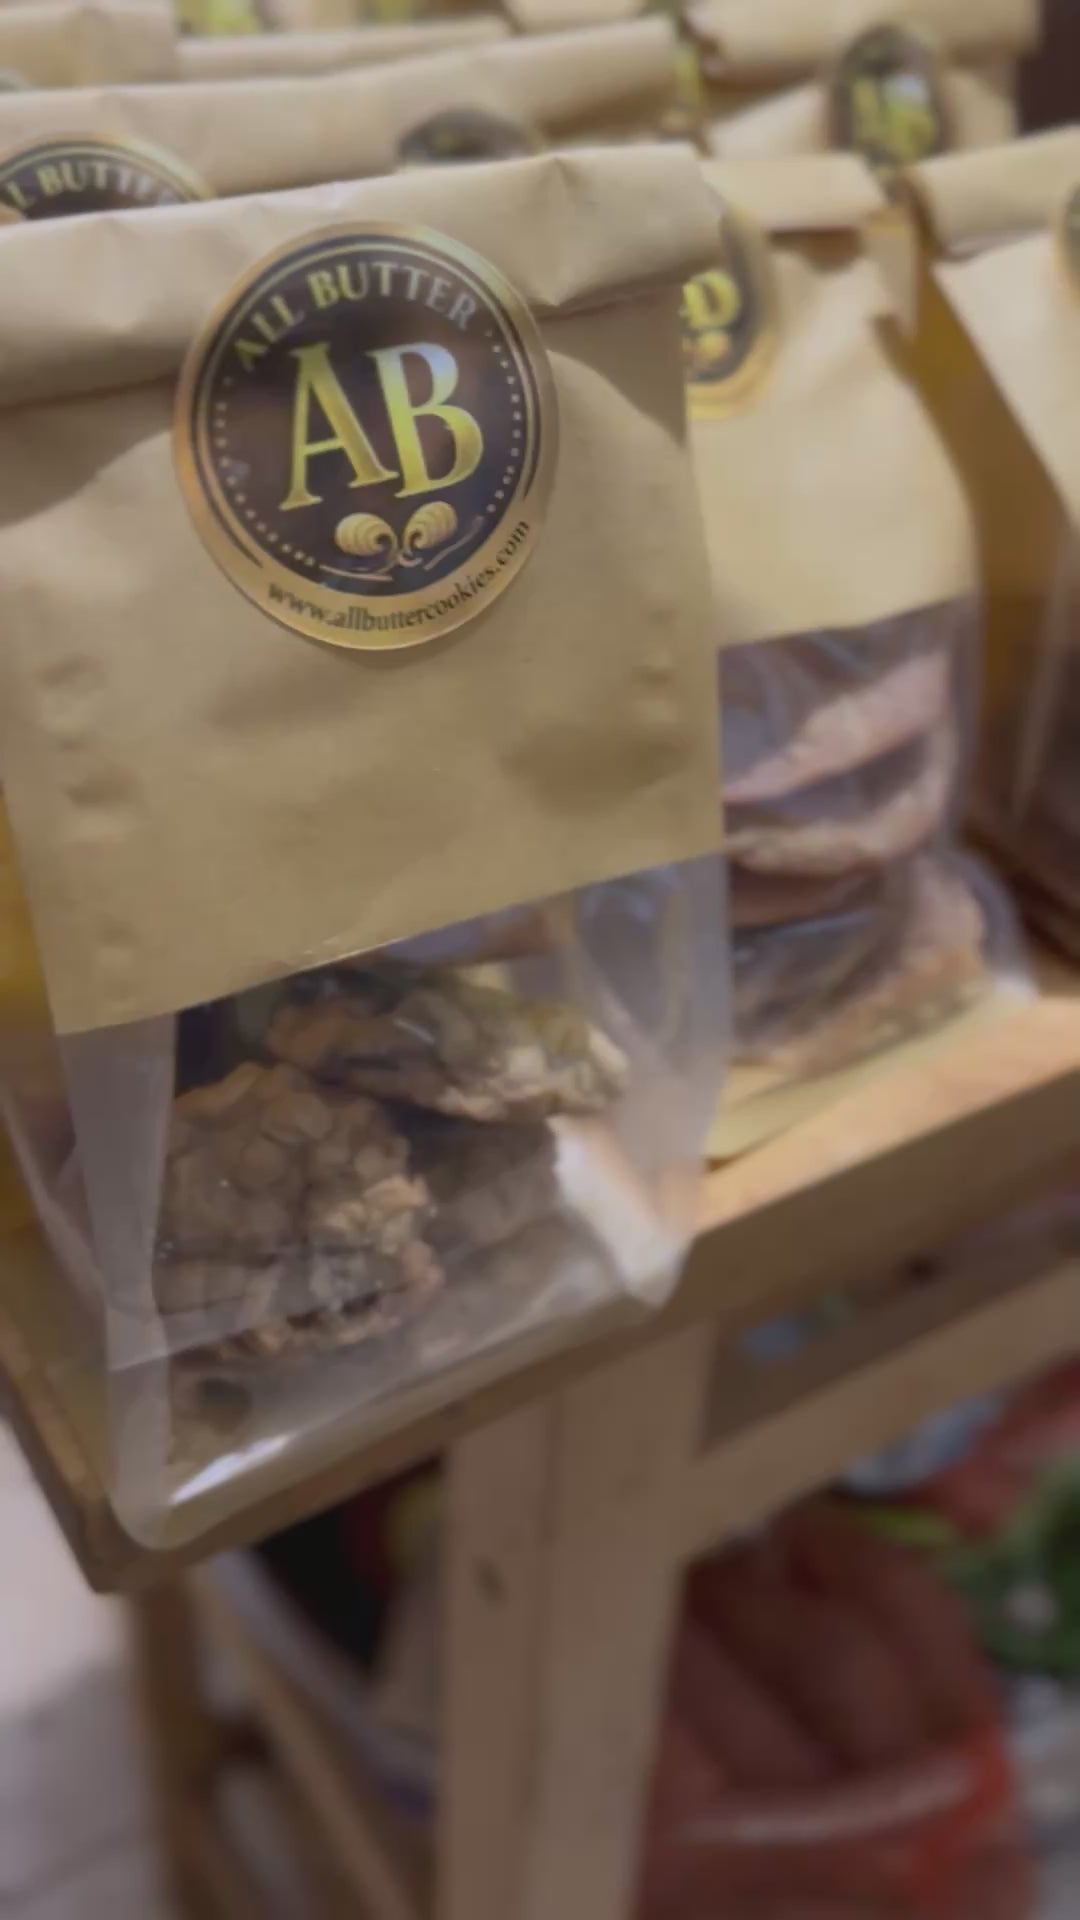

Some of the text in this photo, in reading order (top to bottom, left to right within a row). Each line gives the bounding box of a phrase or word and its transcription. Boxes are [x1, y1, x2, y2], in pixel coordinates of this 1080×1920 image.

[233, 261, 477, 372] ALL BUTTER
[280, 341, 484, 511] AB
[268, 520, 531, 632] www.allbuttercookies.com
